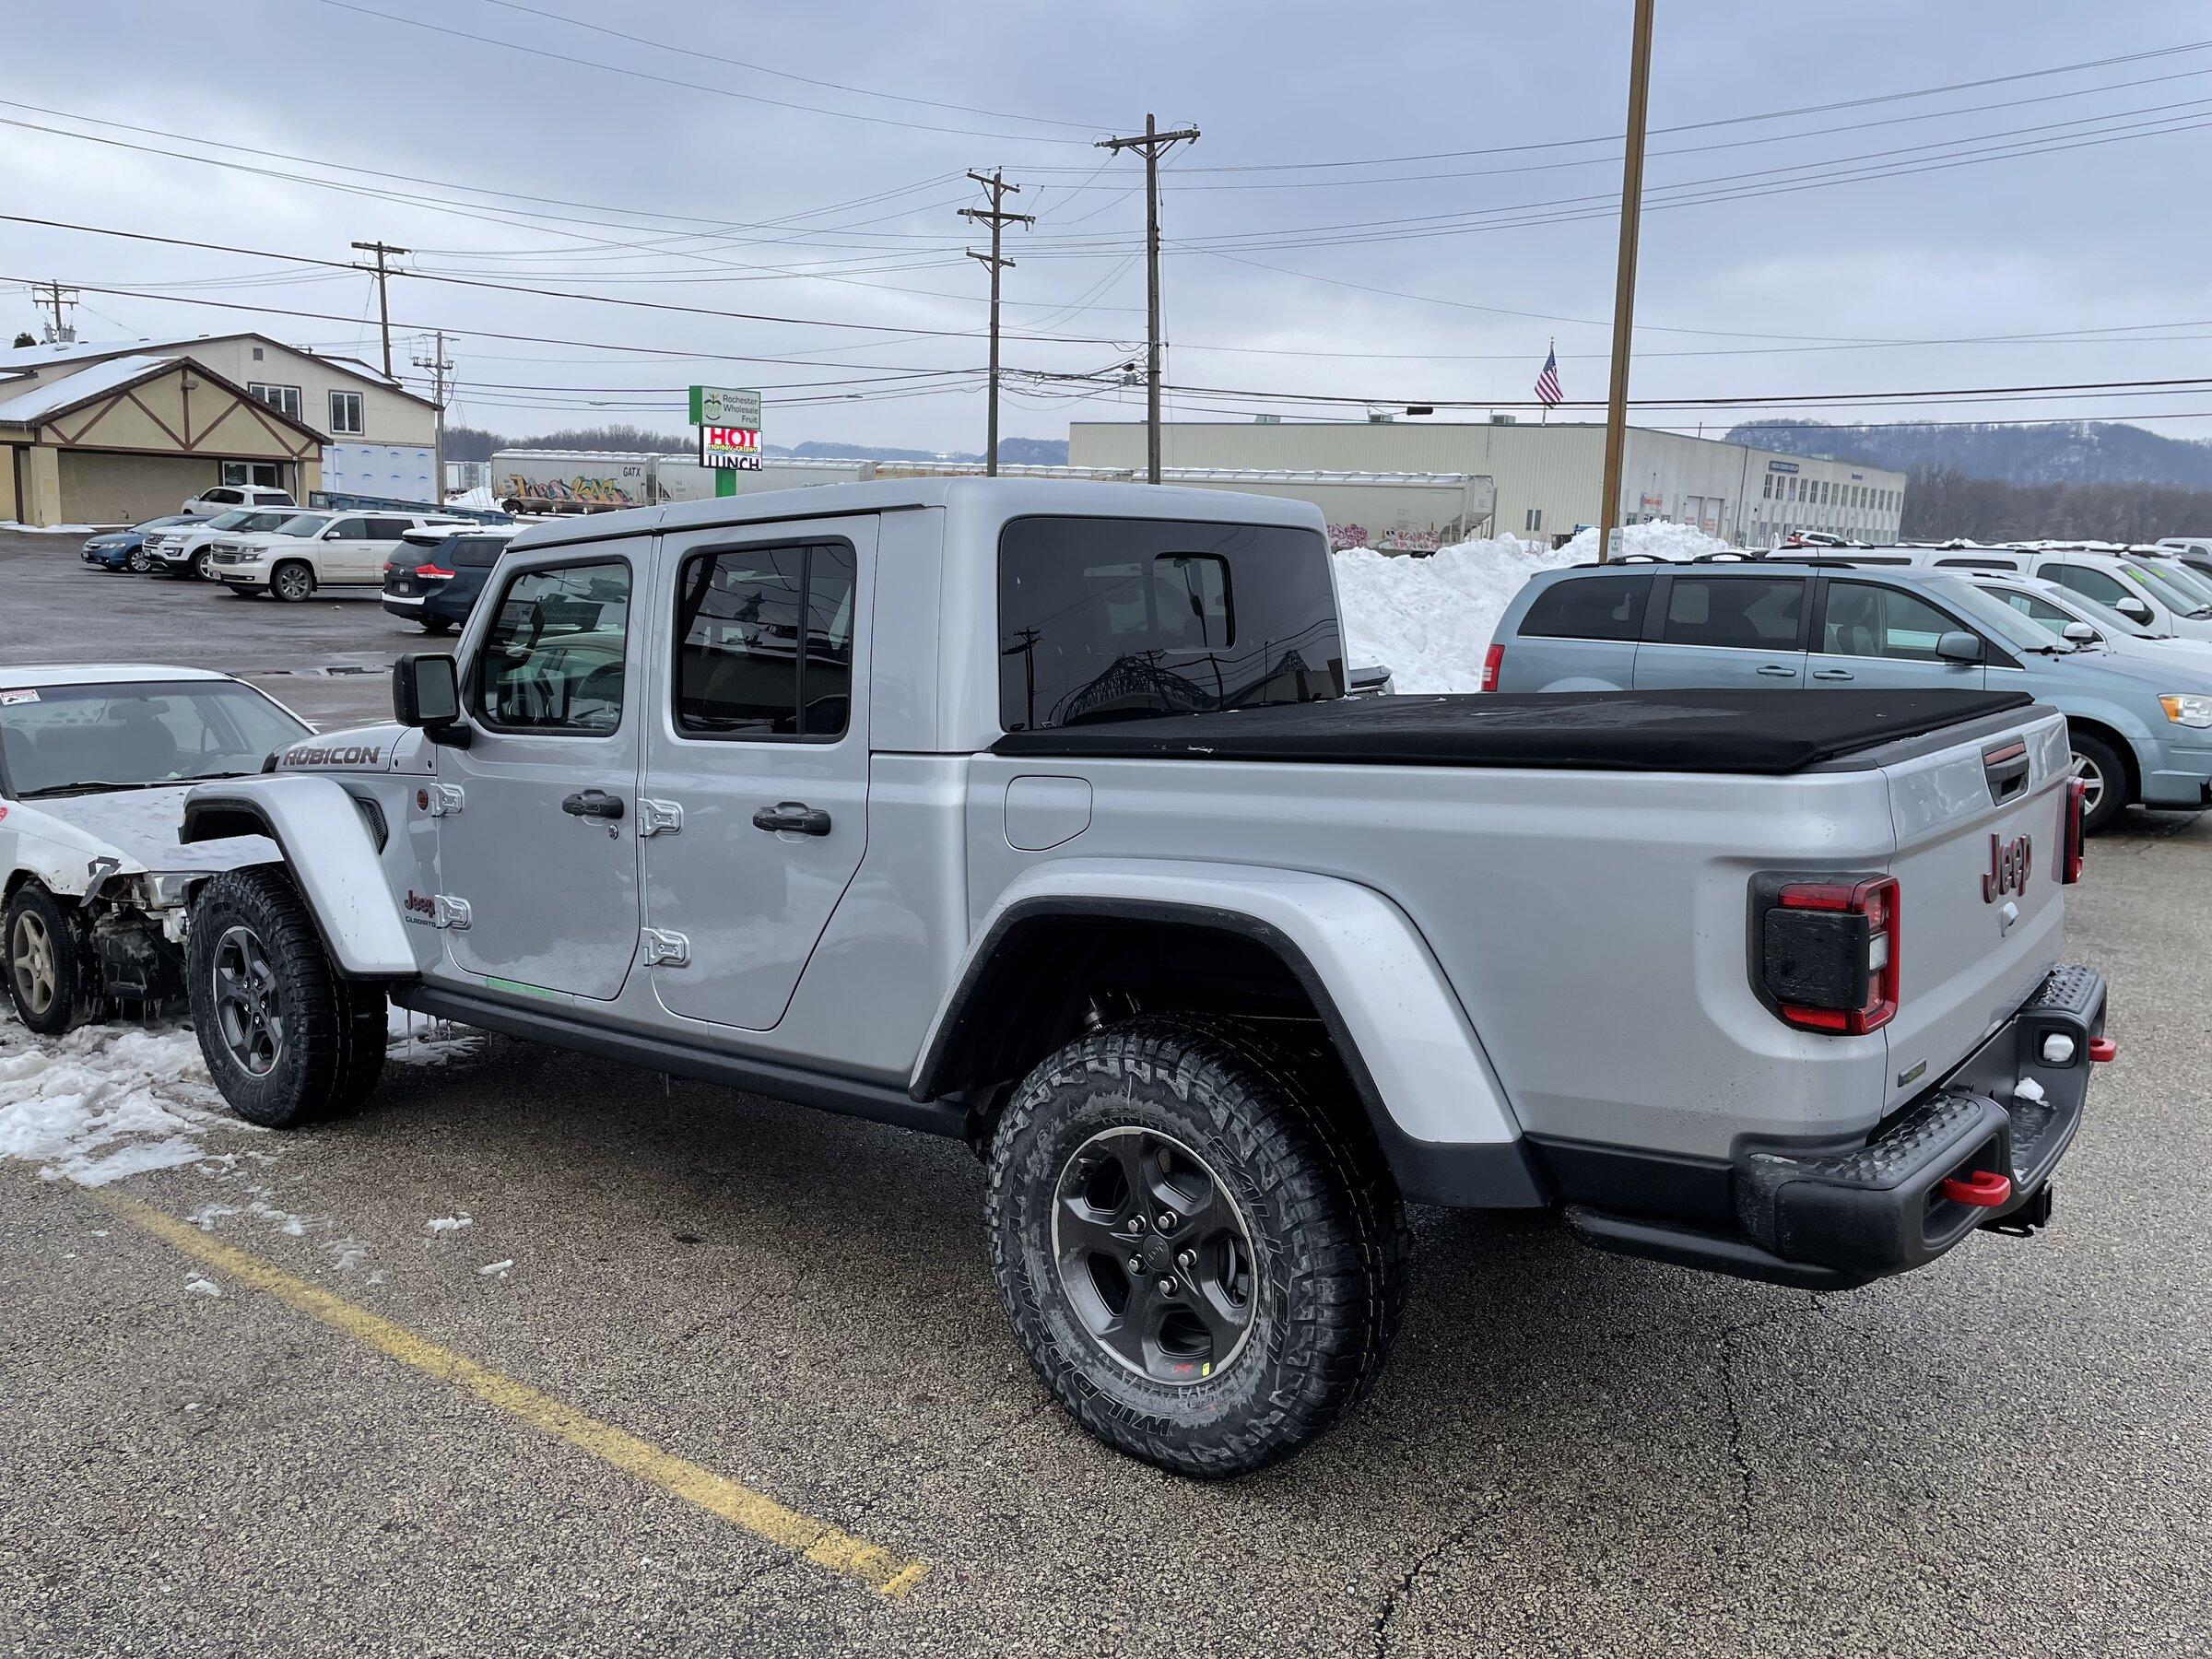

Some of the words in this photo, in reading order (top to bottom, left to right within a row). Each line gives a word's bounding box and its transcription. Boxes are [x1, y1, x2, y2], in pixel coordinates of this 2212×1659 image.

[723, 394, 759, 406] Rochester
[724, 404, 759, 415] Wholesale
[742, 415, 758, 424] Fruit
[711, 428, 758, 448] HOT
[623, 466, 641, 477] GATX
[282, 746, 382, 766] RUBICON
[1983, 833, 2031, 904] Jeep
[404, 889, 436, 918] Jeep
[406, 916, 436, 928] GLADIATO
